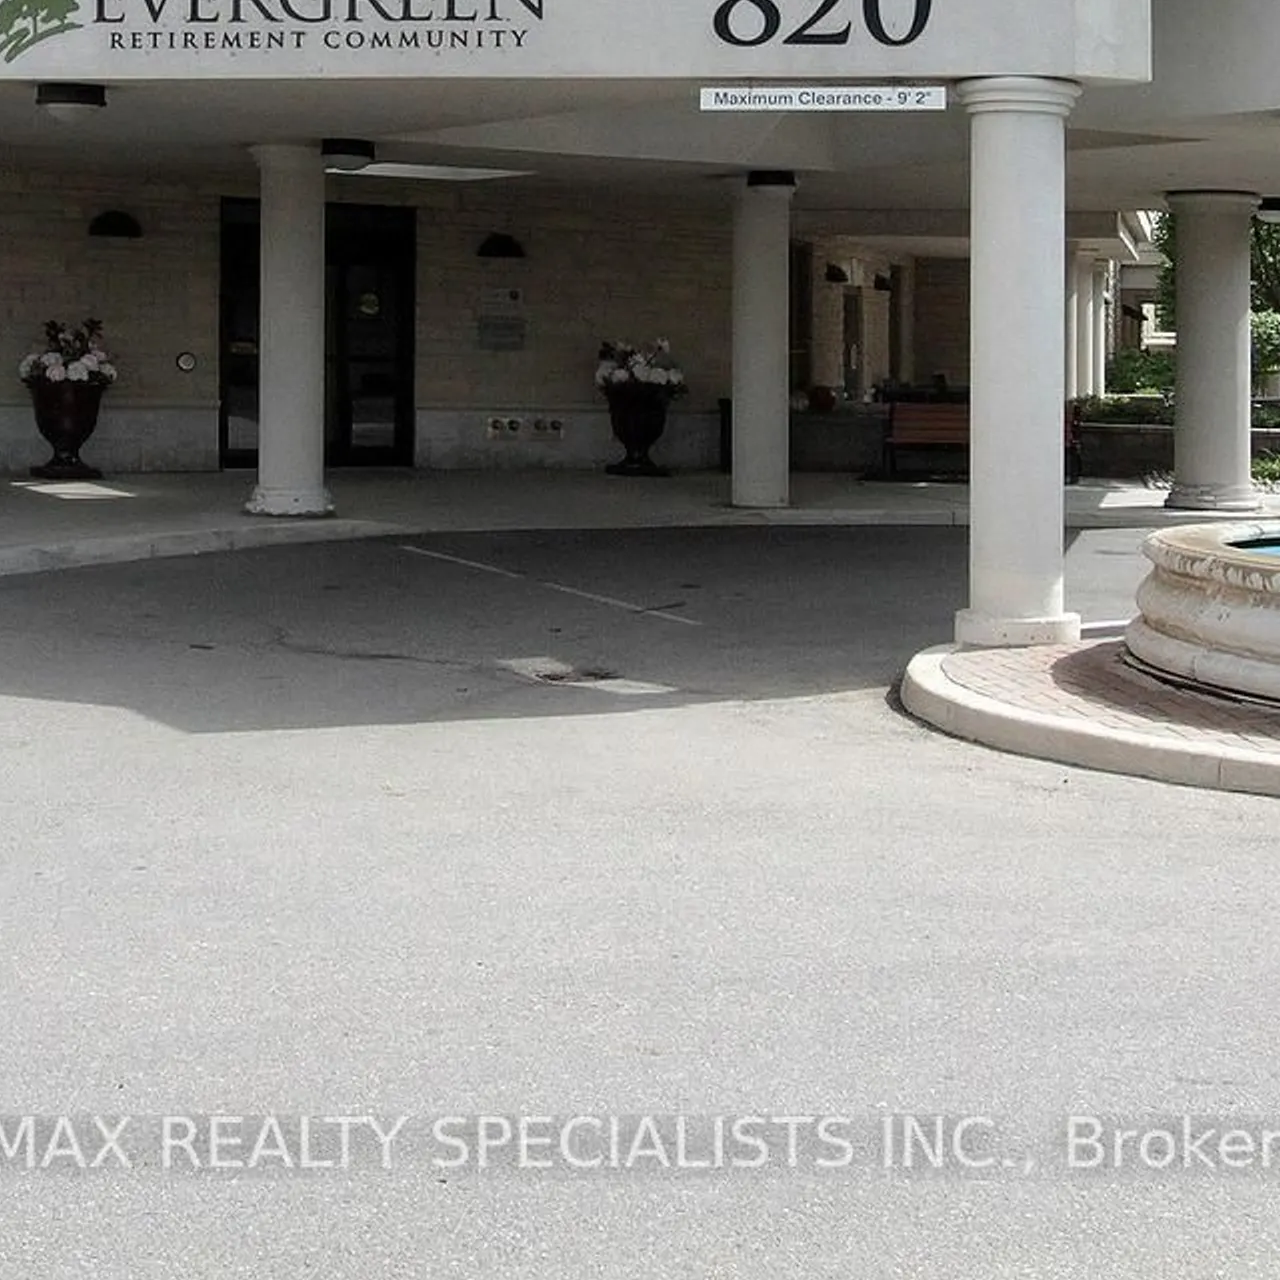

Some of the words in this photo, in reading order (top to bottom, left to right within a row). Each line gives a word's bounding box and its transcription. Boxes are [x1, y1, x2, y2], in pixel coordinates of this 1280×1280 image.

[109, 29, 308, 51] RETIREMENT
[323, 28, 529, 50] COMMUNITY
[713, 91, 794, 106] Maximum
[798, 90, 882, 106] Clearance
